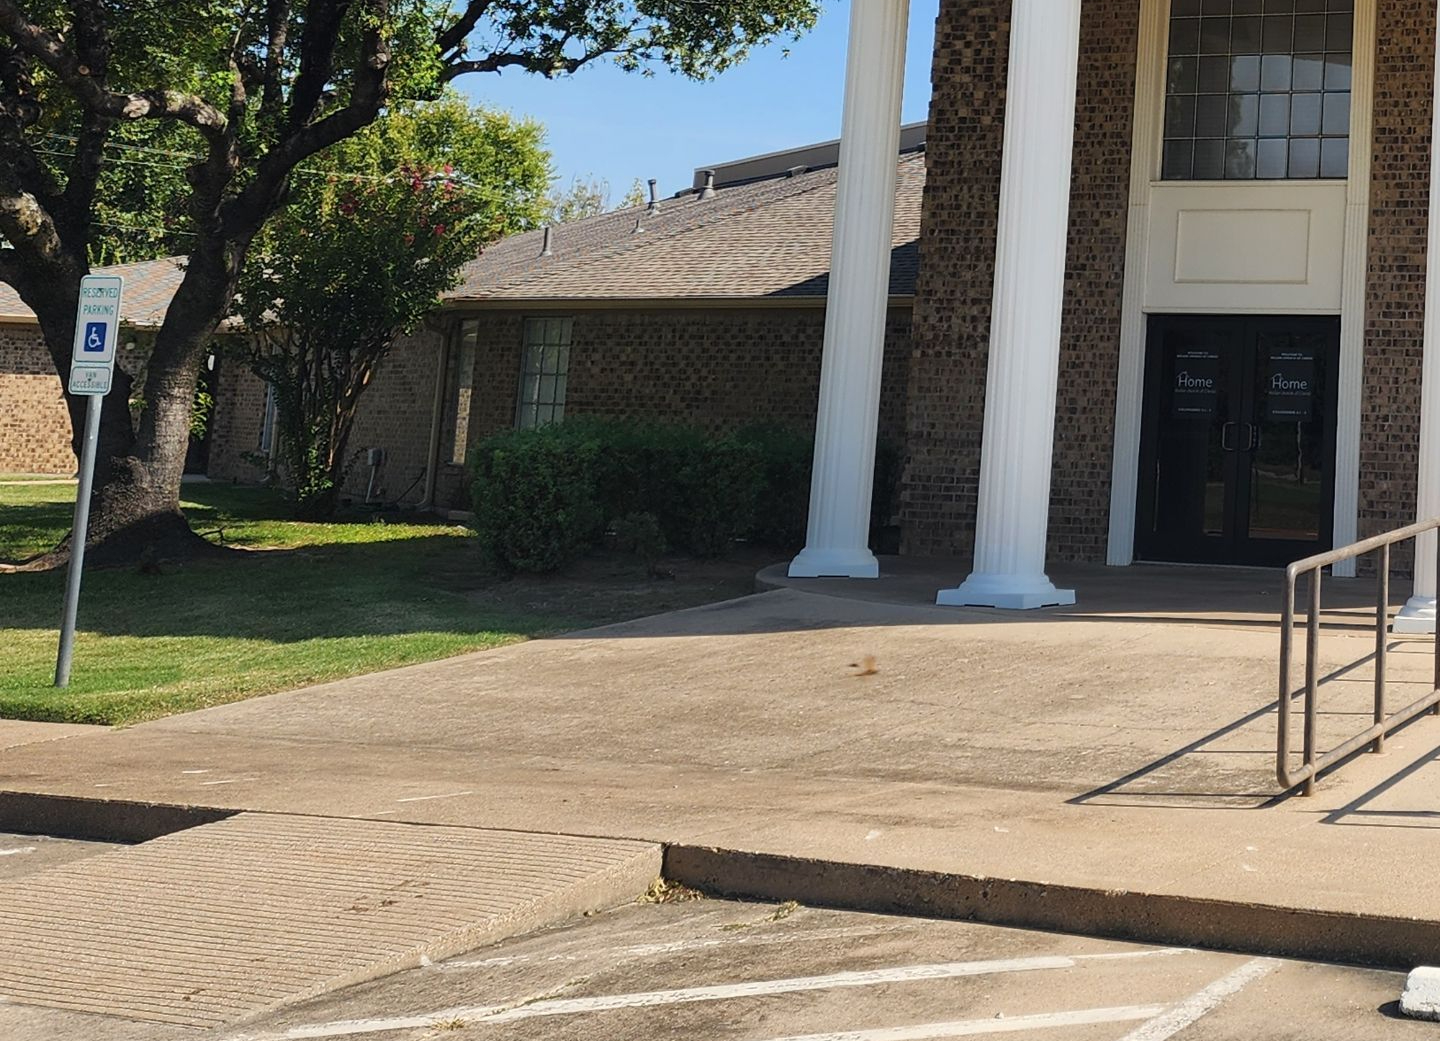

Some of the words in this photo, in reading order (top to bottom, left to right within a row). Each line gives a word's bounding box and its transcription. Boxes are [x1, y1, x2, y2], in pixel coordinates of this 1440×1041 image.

[82, 287, 118, 298] RESERVED
[83, 304, 114, 316] PARKING
[85, 371, 97, 380] VAN
[1177, 373, 1213, 388] Home
[72, 380, 108, 390] ACCESSIBLE
[1271, 375, 1308, 390] Home
